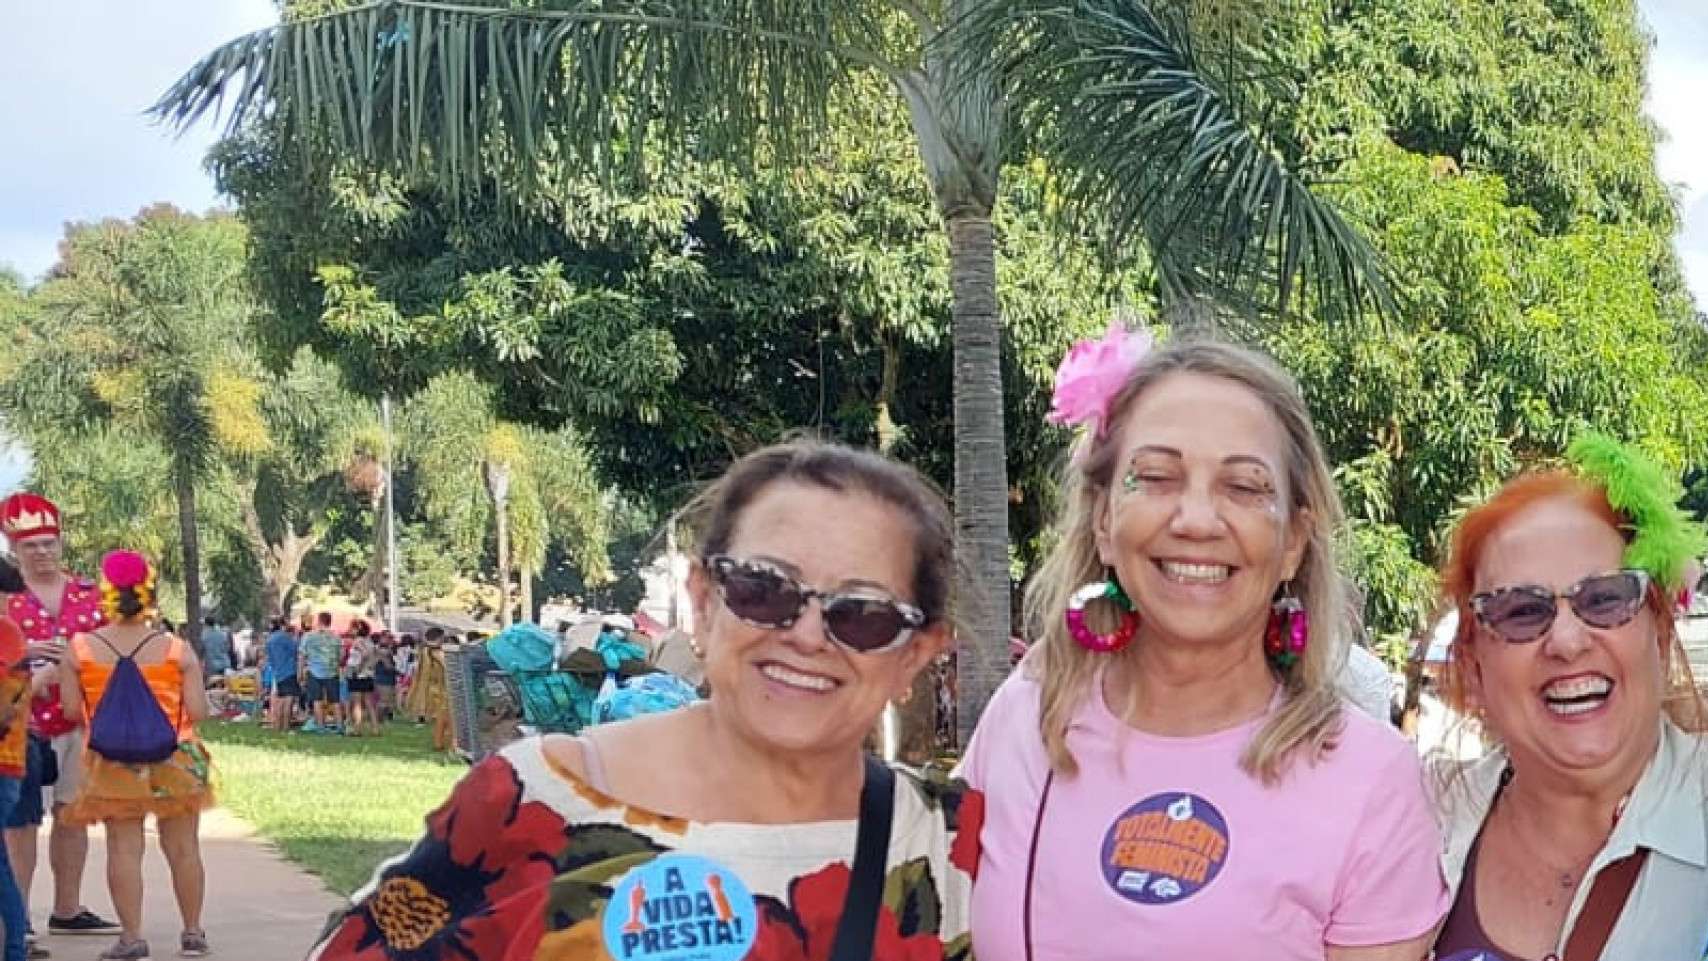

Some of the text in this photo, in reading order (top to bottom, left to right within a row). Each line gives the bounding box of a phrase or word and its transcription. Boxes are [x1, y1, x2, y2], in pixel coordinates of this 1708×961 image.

[665, 866, 685, 891] A
[1109, 838, 1212, 885] FEMINISTA
[643, 891, 716, 924] VIDA
[620, 916, 746, 959] PRESTA!
